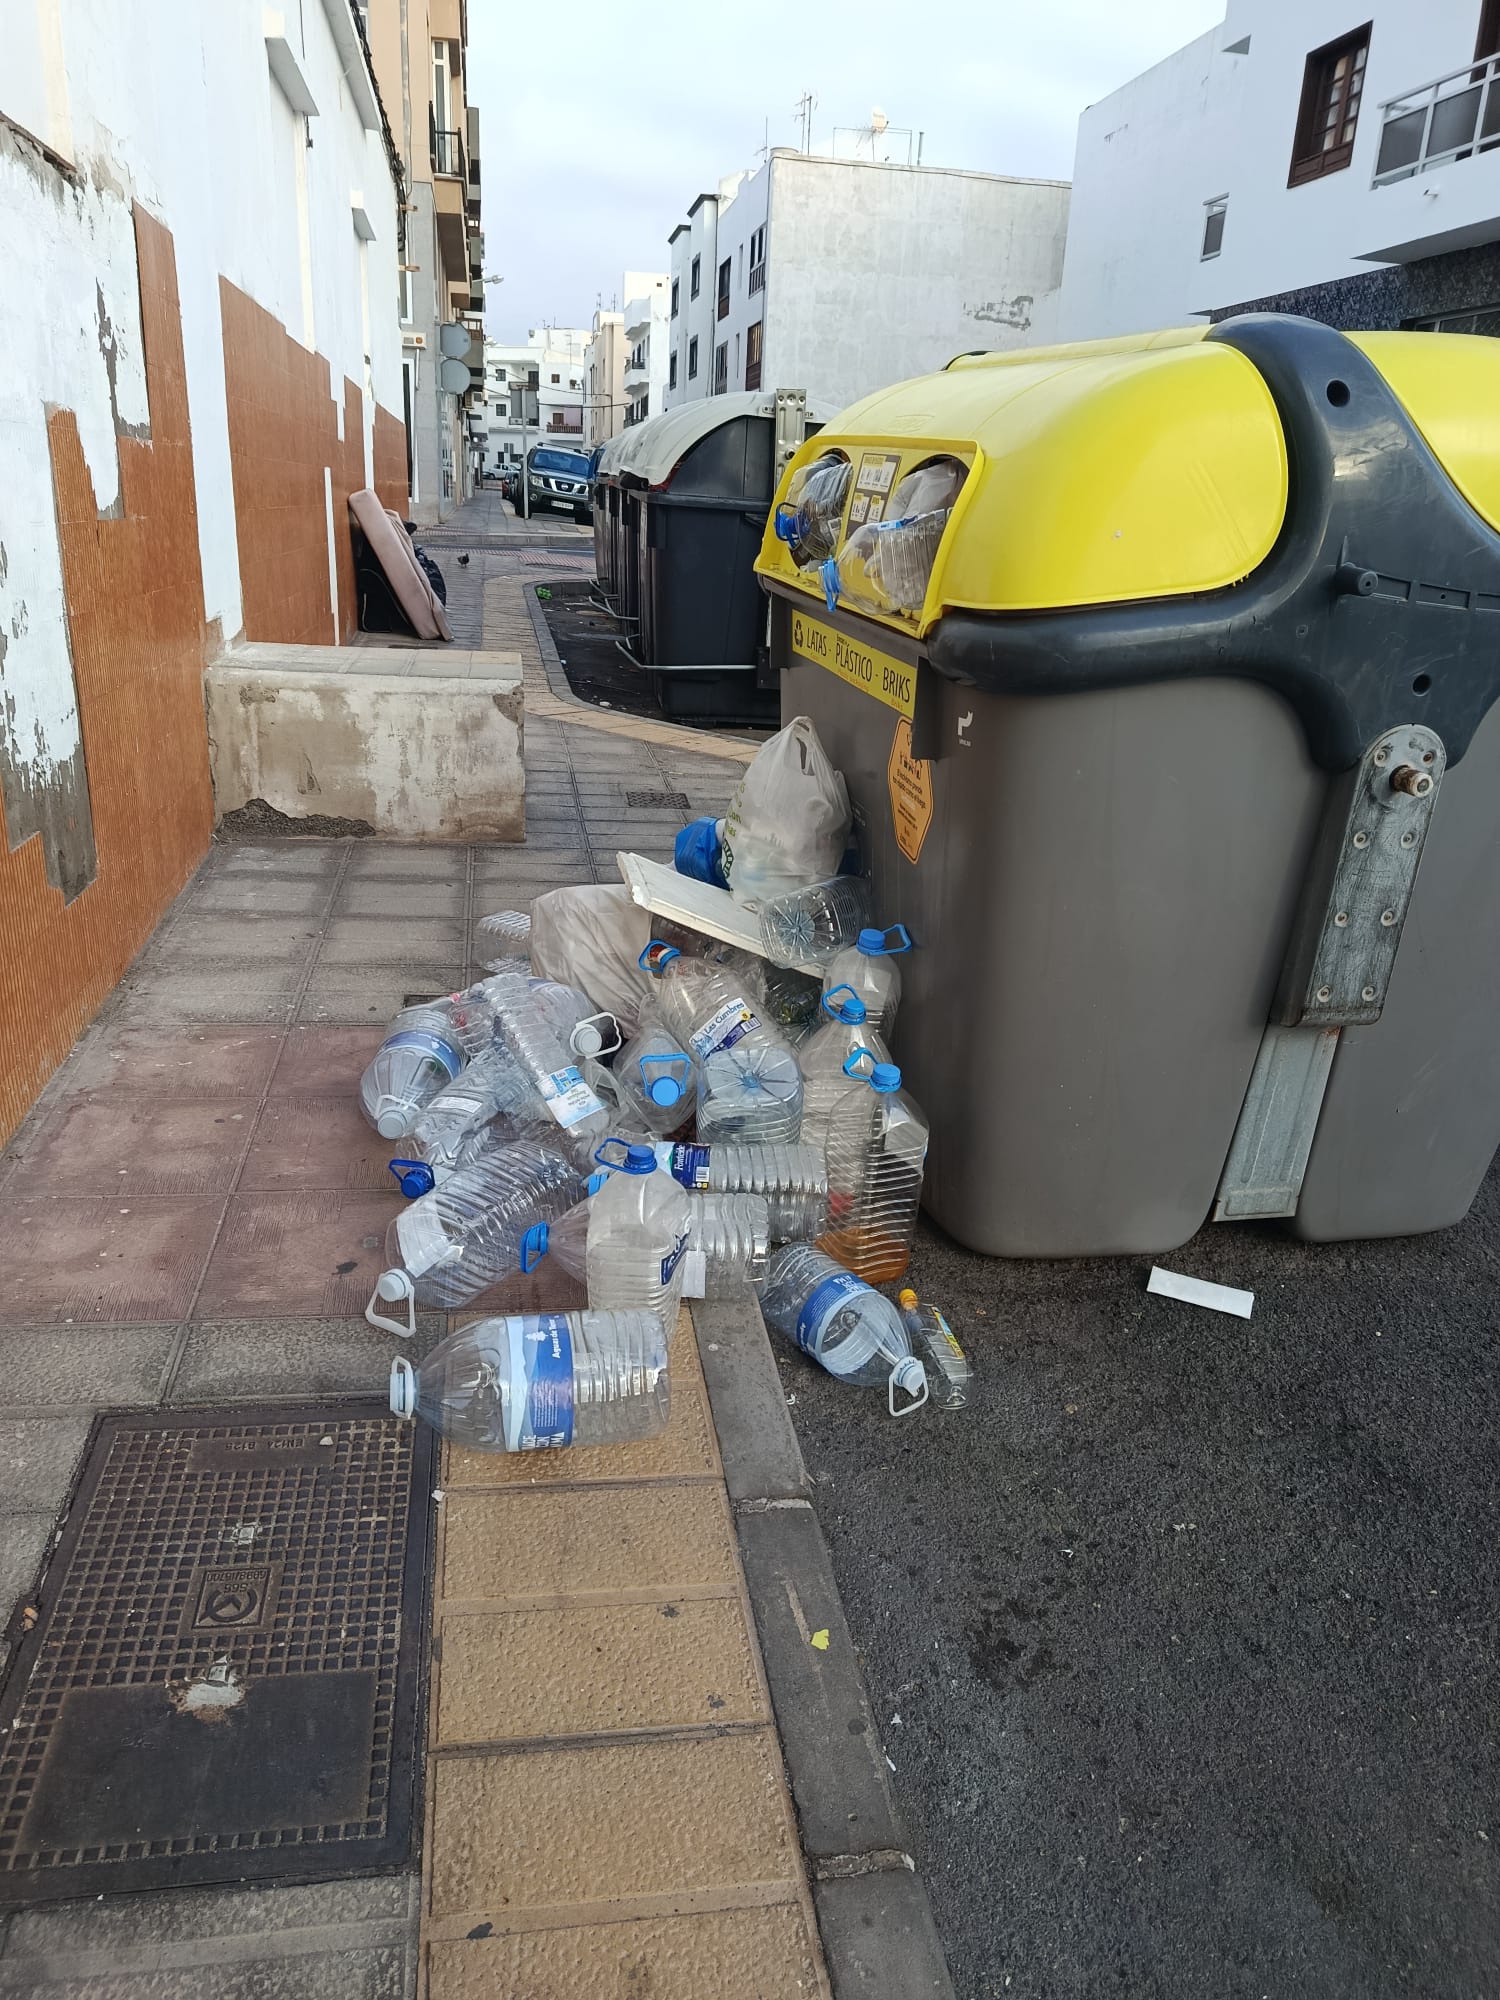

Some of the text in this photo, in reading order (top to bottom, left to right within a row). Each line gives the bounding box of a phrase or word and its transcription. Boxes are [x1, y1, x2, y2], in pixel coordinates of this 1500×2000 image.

[806, 627, 827, 657] LATAS
[835, 643, 872, 682] PLÁSTICO
[882, 667, 911, 703] BRIKS
[715, 1002, 744, 1024] Cumbres
[552, 1338, 561, 1359] Aguas
